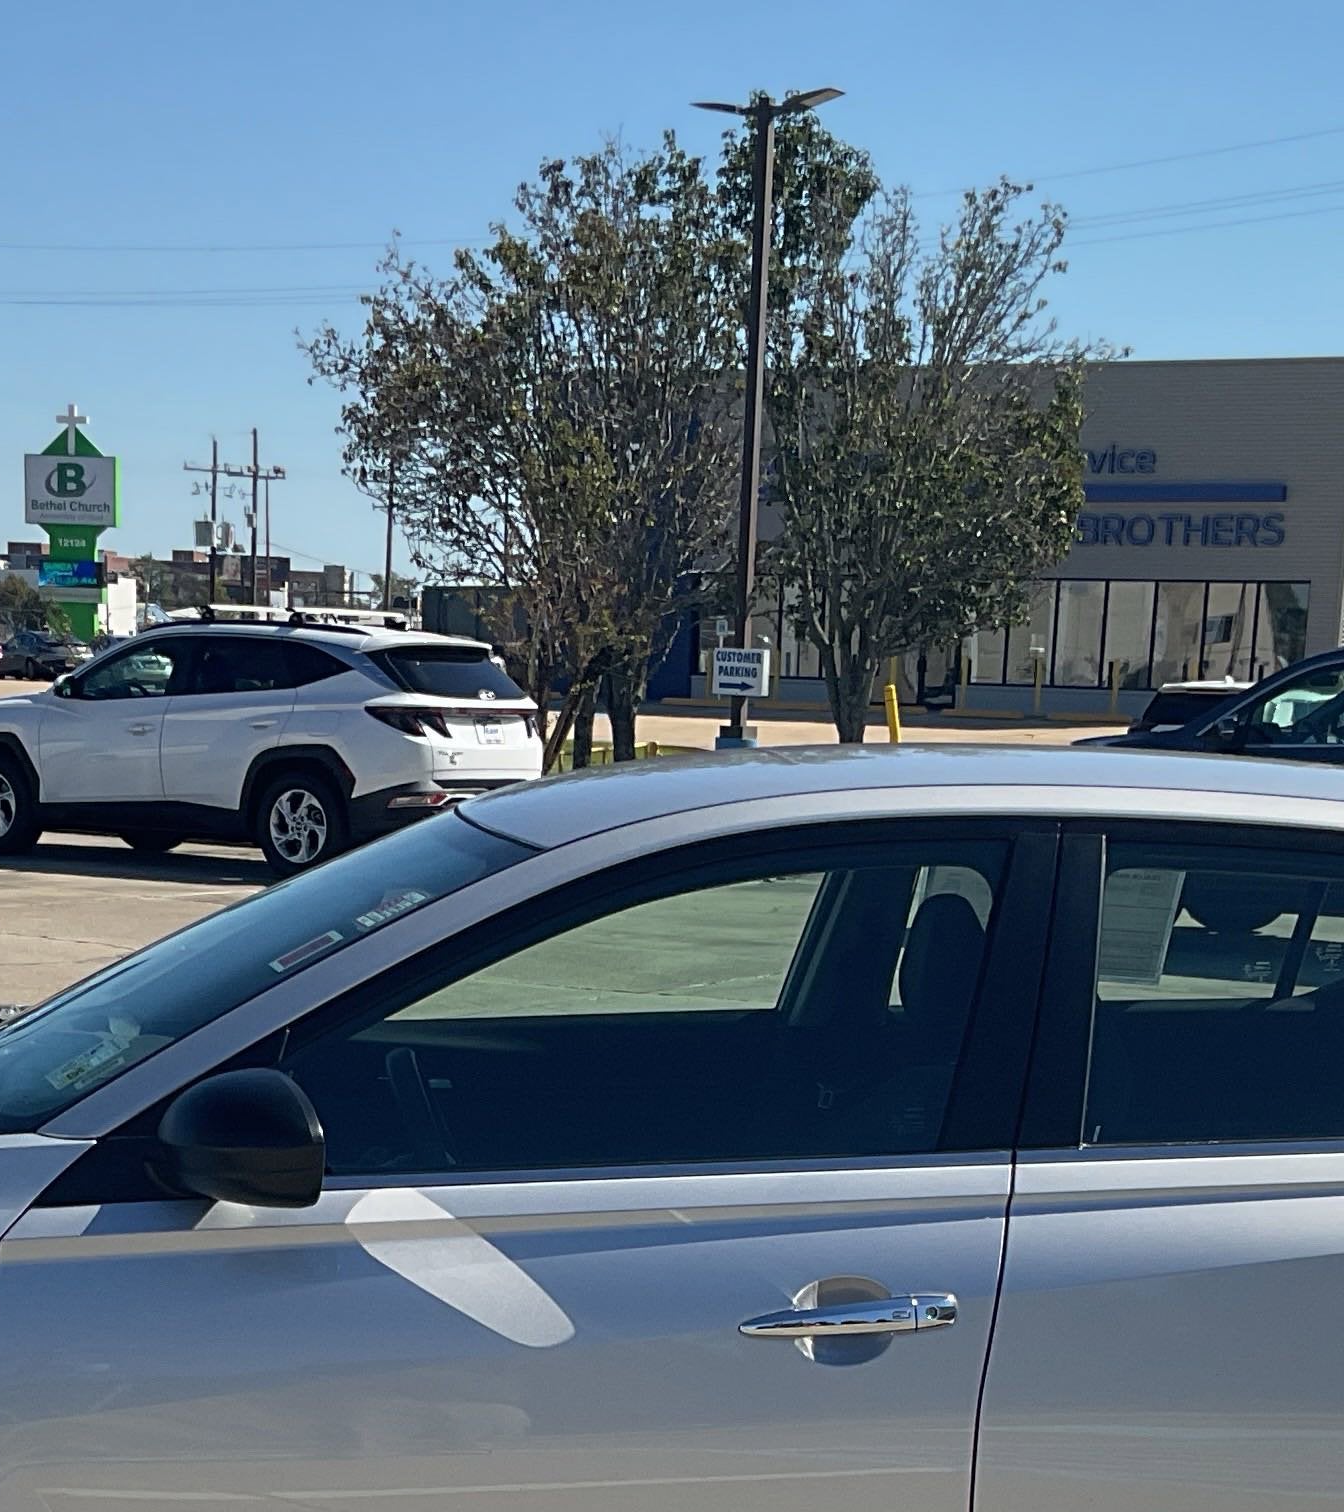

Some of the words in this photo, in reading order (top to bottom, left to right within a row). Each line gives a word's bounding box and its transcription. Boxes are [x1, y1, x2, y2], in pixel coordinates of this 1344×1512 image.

[1086, 442, 1157, 475] vice
[57, 462, 87, 498] B
[31, 499, 67, 511] Bethel
[69, 501, 111, 513] Church
[1075, 511, 1287, 547] BROTHERS
[716, 651, 762, 664] CUSTOMER
[718, 665, 758, 678] PARKING
